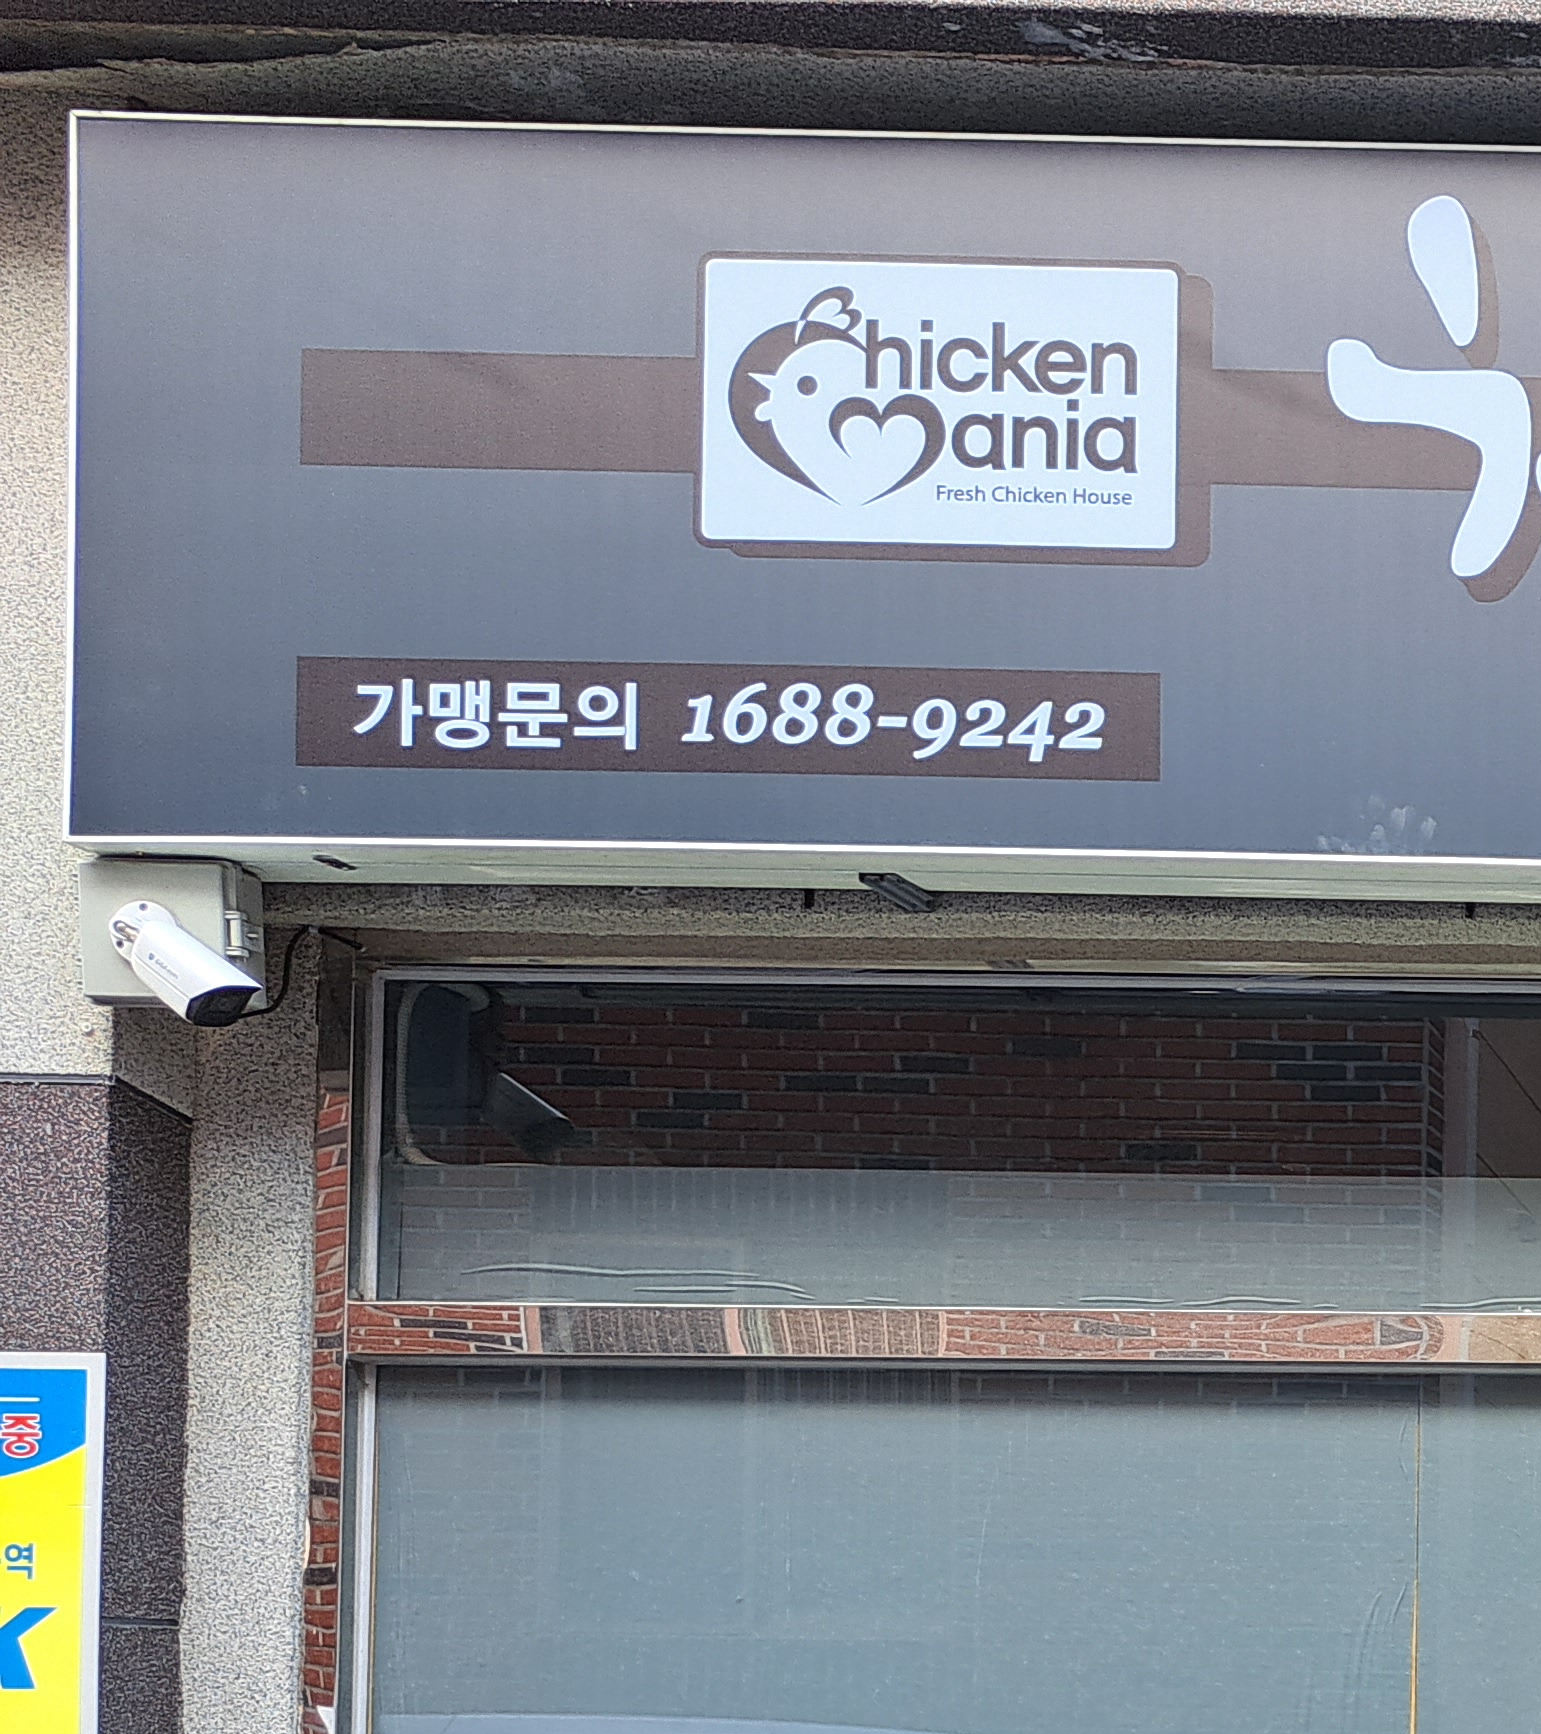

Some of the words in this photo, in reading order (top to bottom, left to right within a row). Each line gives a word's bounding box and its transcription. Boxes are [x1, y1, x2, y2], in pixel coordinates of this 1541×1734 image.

[936, 483, 986, 504] Fresh
[991, 485, 1066, 505] Chicken
[1072, 487, 1133, 506] House
[353, 680, 639, 750] 가맹문의
[682, 682, 1105, 762] 1688-9242
